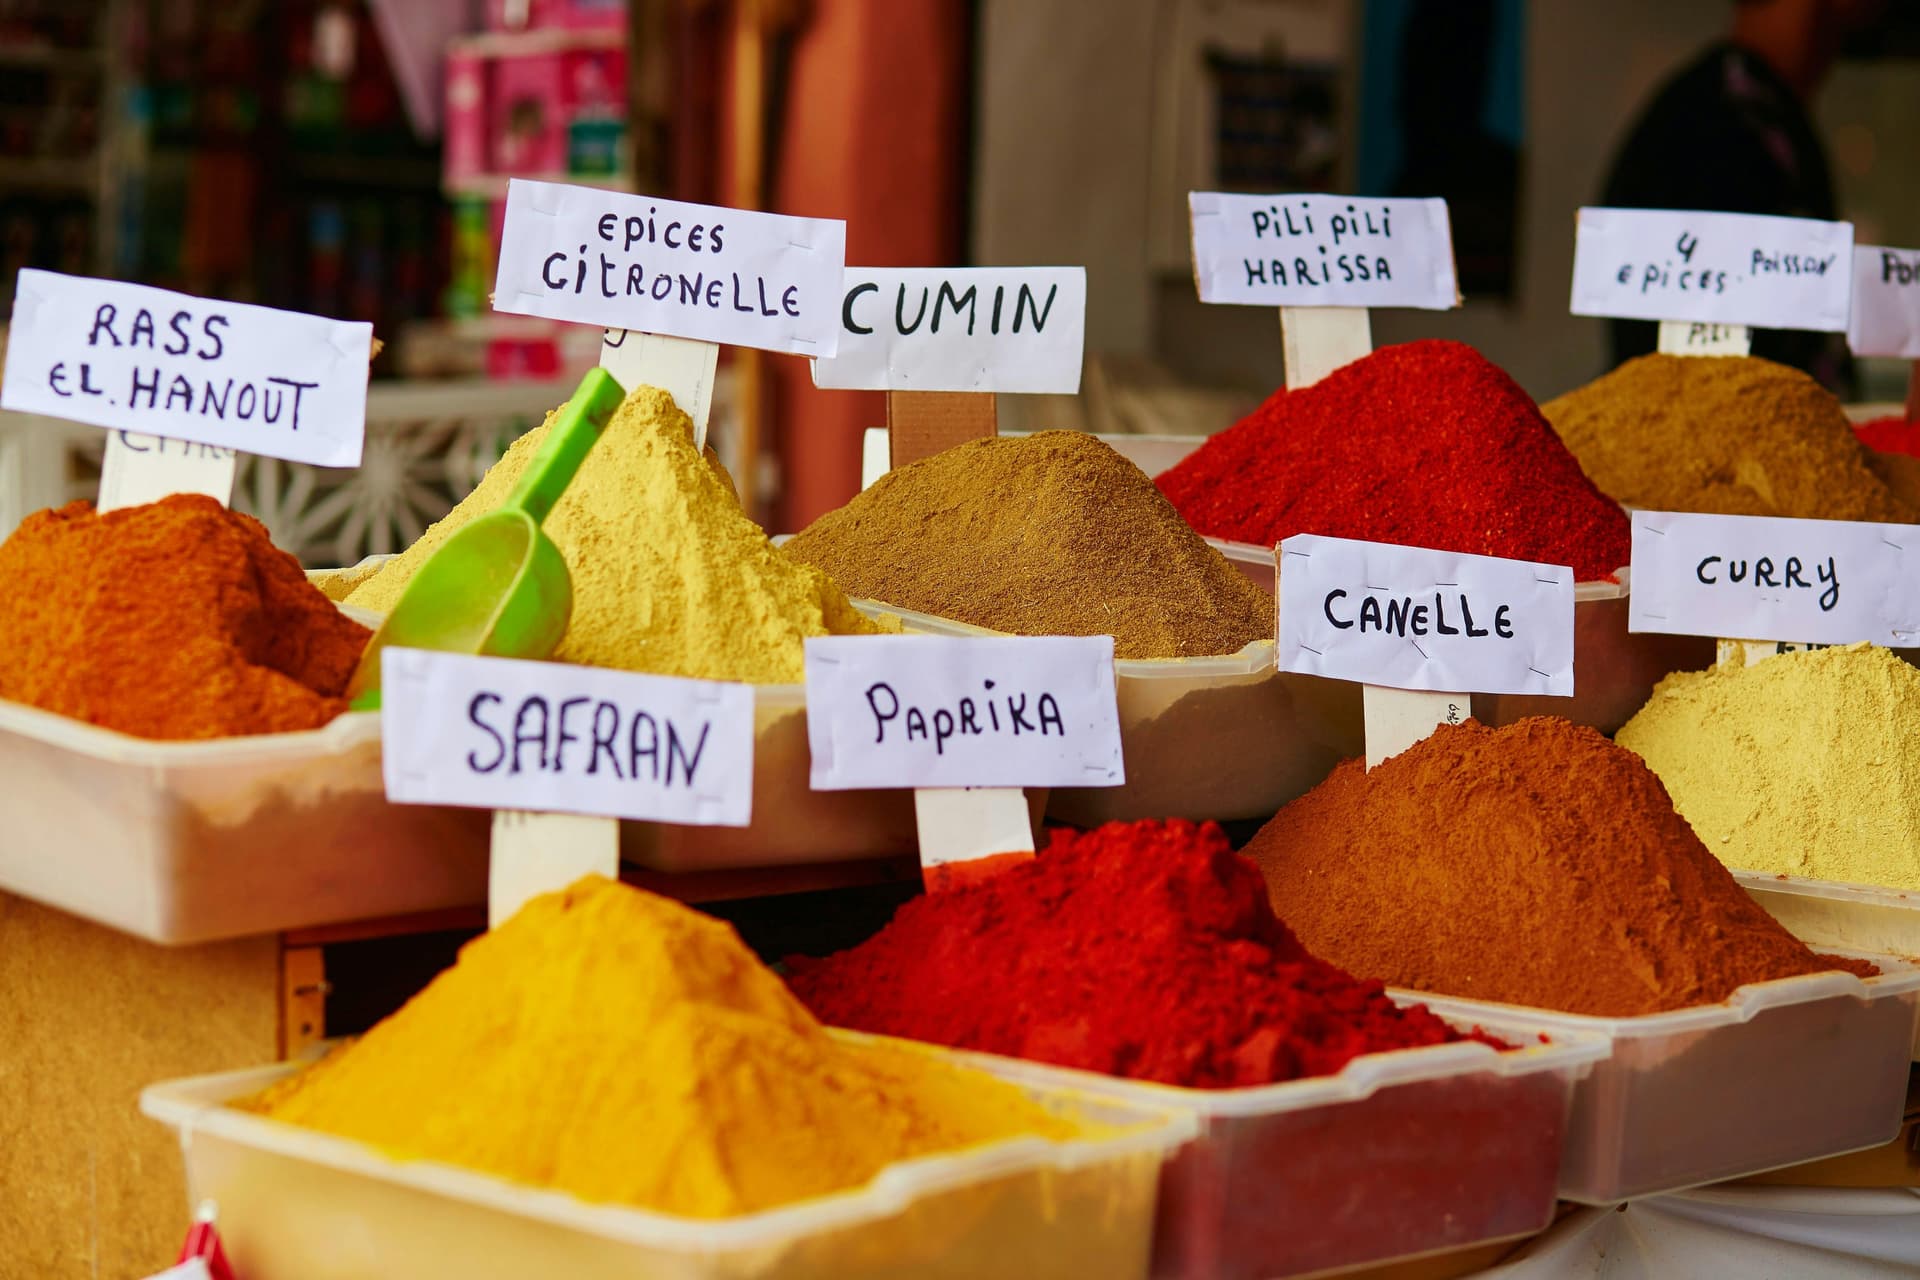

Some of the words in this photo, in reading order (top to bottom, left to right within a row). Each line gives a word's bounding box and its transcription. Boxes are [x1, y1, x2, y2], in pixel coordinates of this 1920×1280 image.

[1676, 231, 1699, 264] 4
[88, 302, 231, 361] RASS
[841, 280, 1059, 337] CUMIN
[128, 365, 320, 431] HANOUT
[1323, 587, 1515, 639] CANELLE
[467, 691, 711, 787] SAFRAN
